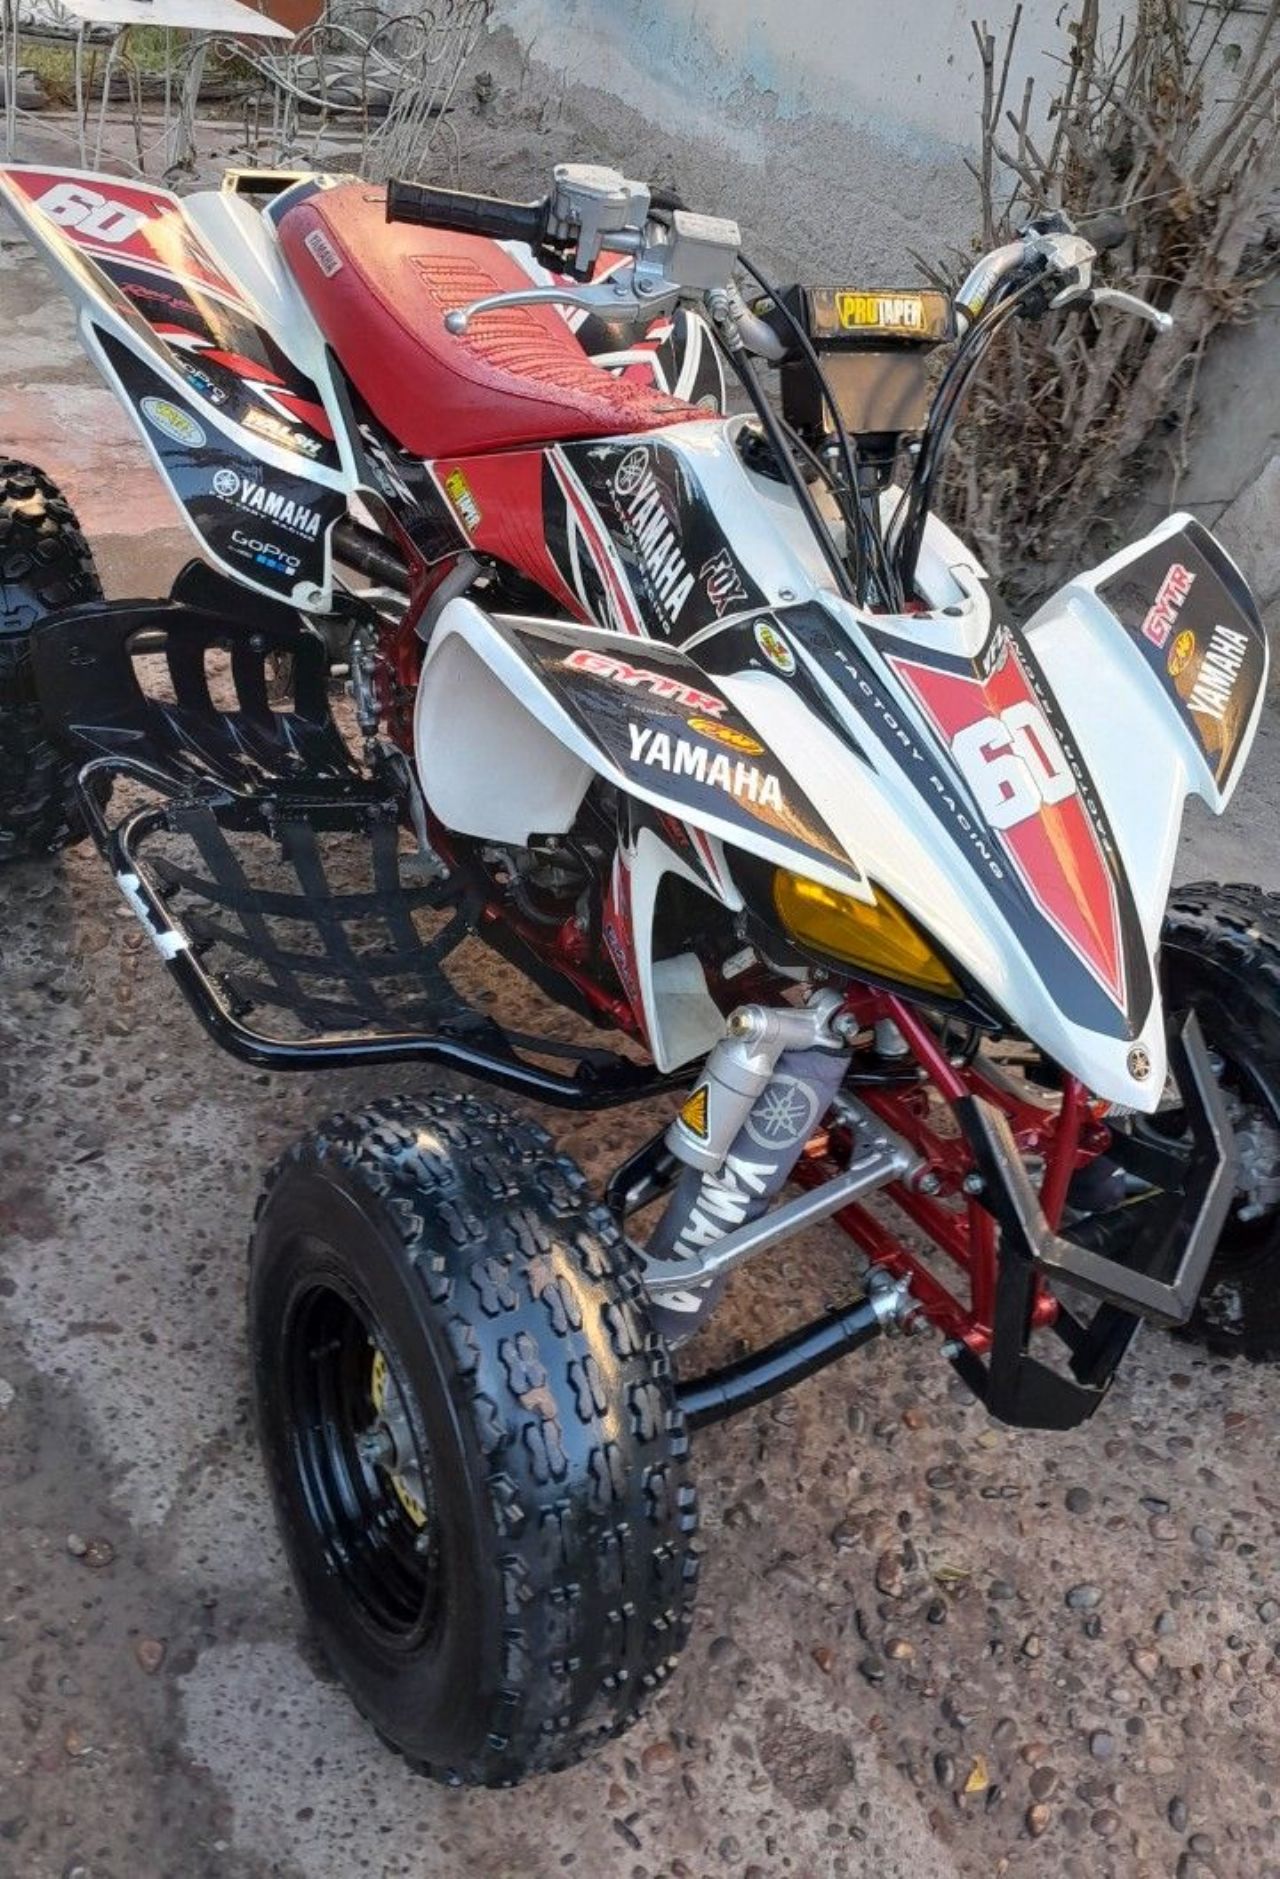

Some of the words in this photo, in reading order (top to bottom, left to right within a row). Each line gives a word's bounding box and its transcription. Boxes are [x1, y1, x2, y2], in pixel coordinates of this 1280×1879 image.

[33, 183, 150, 243] 60
[231, 529, 301, 569] GoPro
[241, 478, 321, 536] YAMAHA
[627, 471, 695, 624] YAMAHA
[701, 548, 748, 618] FOX
[1141, 562, 1197, 650] GYTR
[562, 648, 729, 719] GYTR
[1186, 624, 1248, 721] YAMAHA
[627, 722, 786, 814] YAMAHA
[833, 648, 926, 763] FACTORY
[928, 773, 1006, 881] RACING
[949, 699, 1079, 831] 60
[648, 1153, 779, 1314] YAMAA
